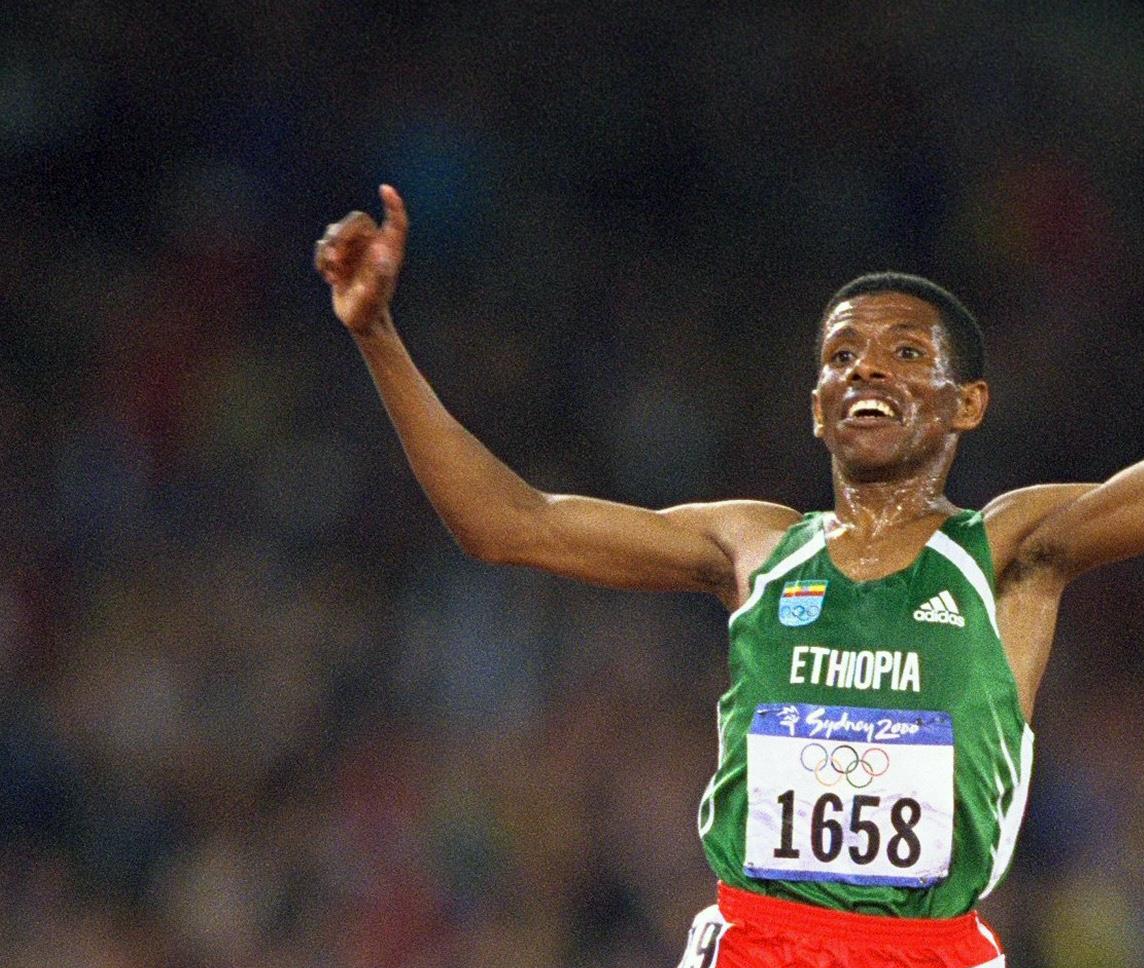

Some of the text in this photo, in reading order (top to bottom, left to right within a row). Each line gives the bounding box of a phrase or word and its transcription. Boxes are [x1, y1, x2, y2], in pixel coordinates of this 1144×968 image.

[912, 609, 966, 628] adidas
[789, 645, 921, 692] ETHIOPIA
[805, 706, 920, 743] Sydney 2000
[773, 789, 922, 869] 1658
